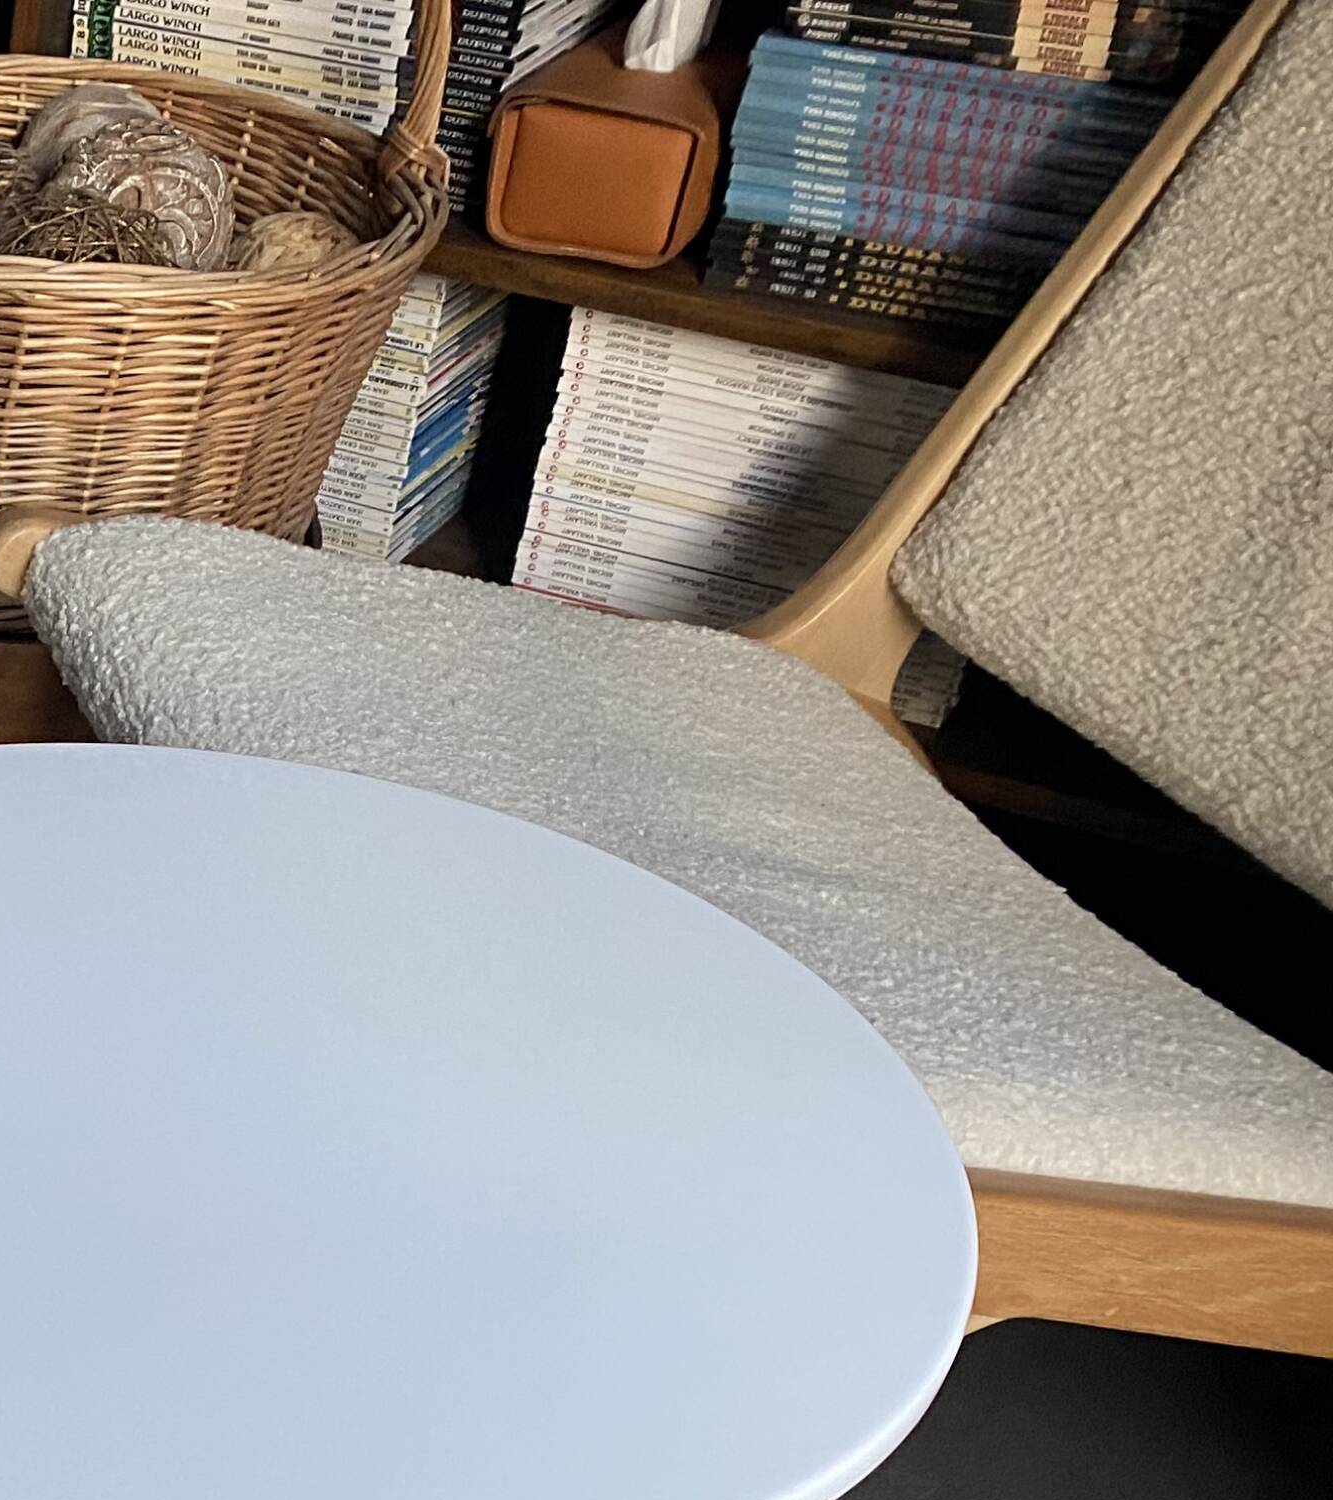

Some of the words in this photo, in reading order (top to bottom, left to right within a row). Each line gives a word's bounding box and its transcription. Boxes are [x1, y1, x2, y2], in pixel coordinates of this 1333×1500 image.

[120, 8, 159, 23] LARGO
[163, 17, 201, 32] WINCH
[171, 1, 210, 16] WINCH
[118, 26, 158, 41] LARGO
[162, 34, 200, 49] WINCH
[119, 37, 158, 52] LARGO
[163, 45, 201, 60] WINCH
[117, 53, 156, 68] LARGO
[160, 62, 199, 77] WINCH
